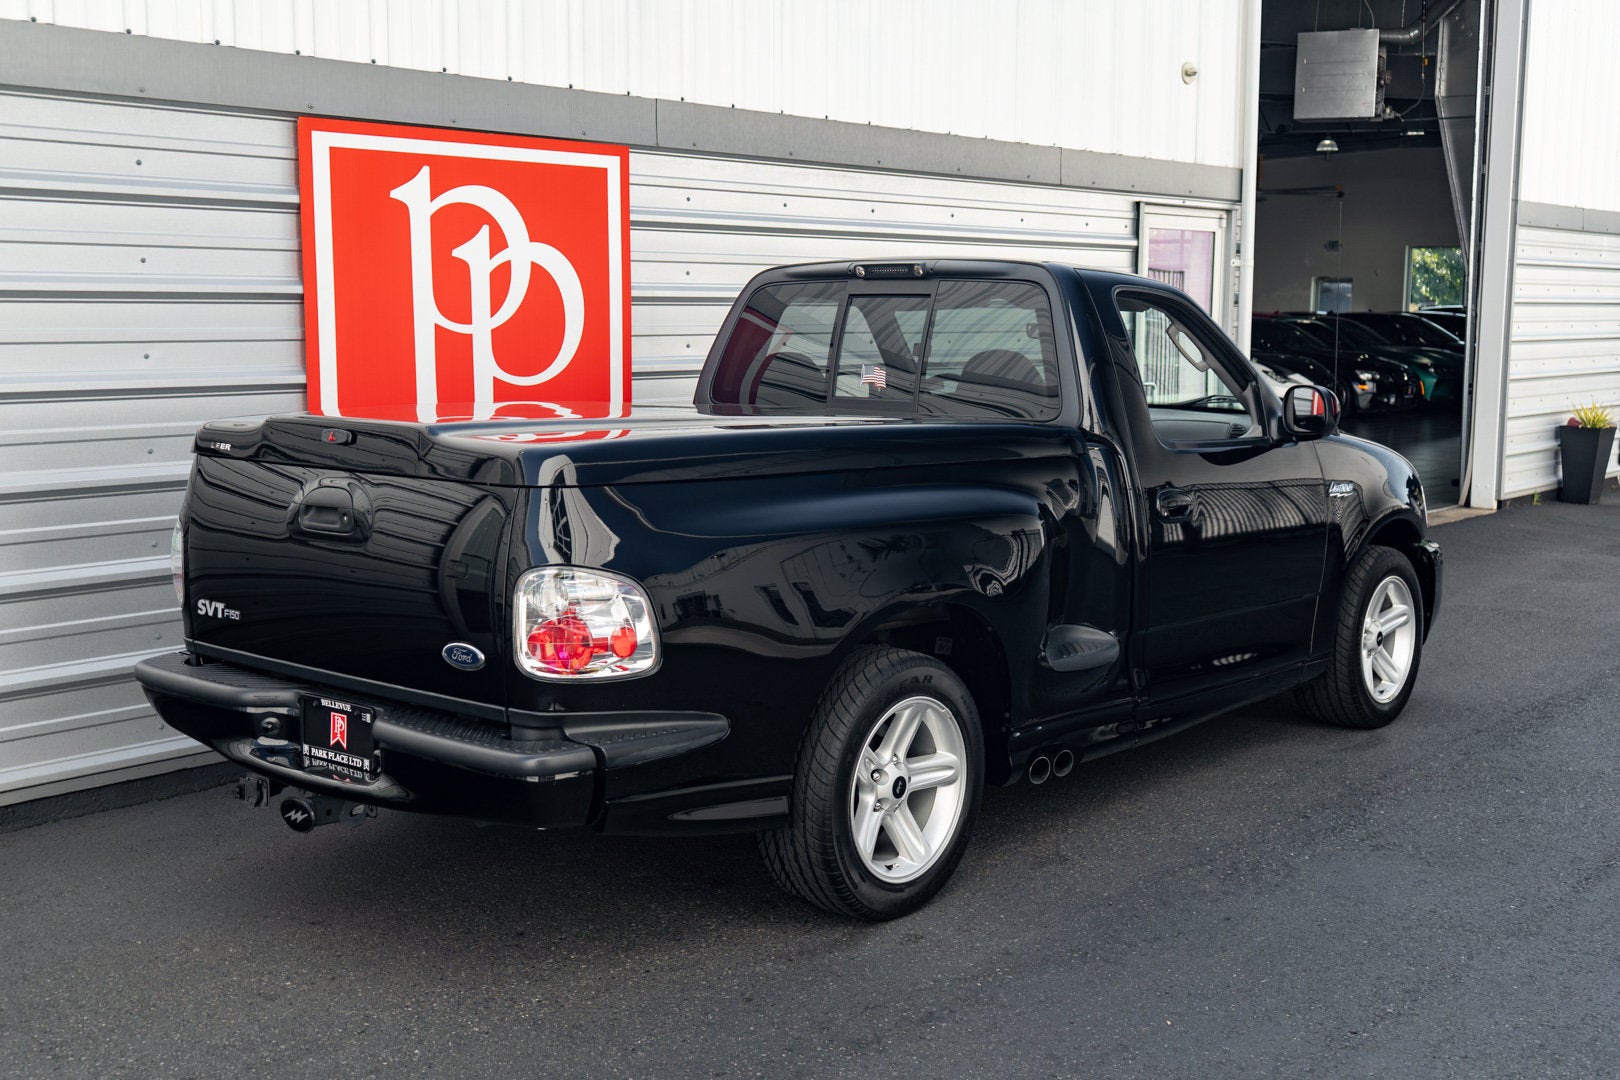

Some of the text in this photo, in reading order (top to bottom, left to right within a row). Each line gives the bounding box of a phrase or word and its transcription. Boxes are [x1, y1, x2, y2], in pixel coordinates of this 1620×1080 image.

[197, 598, 226, 619] SVT
[451, 647, 473, 663] Ford
[320, 699, 352, 712] BELLEVUE
[311, 747, 362, 768] PARK PLACE LTD
